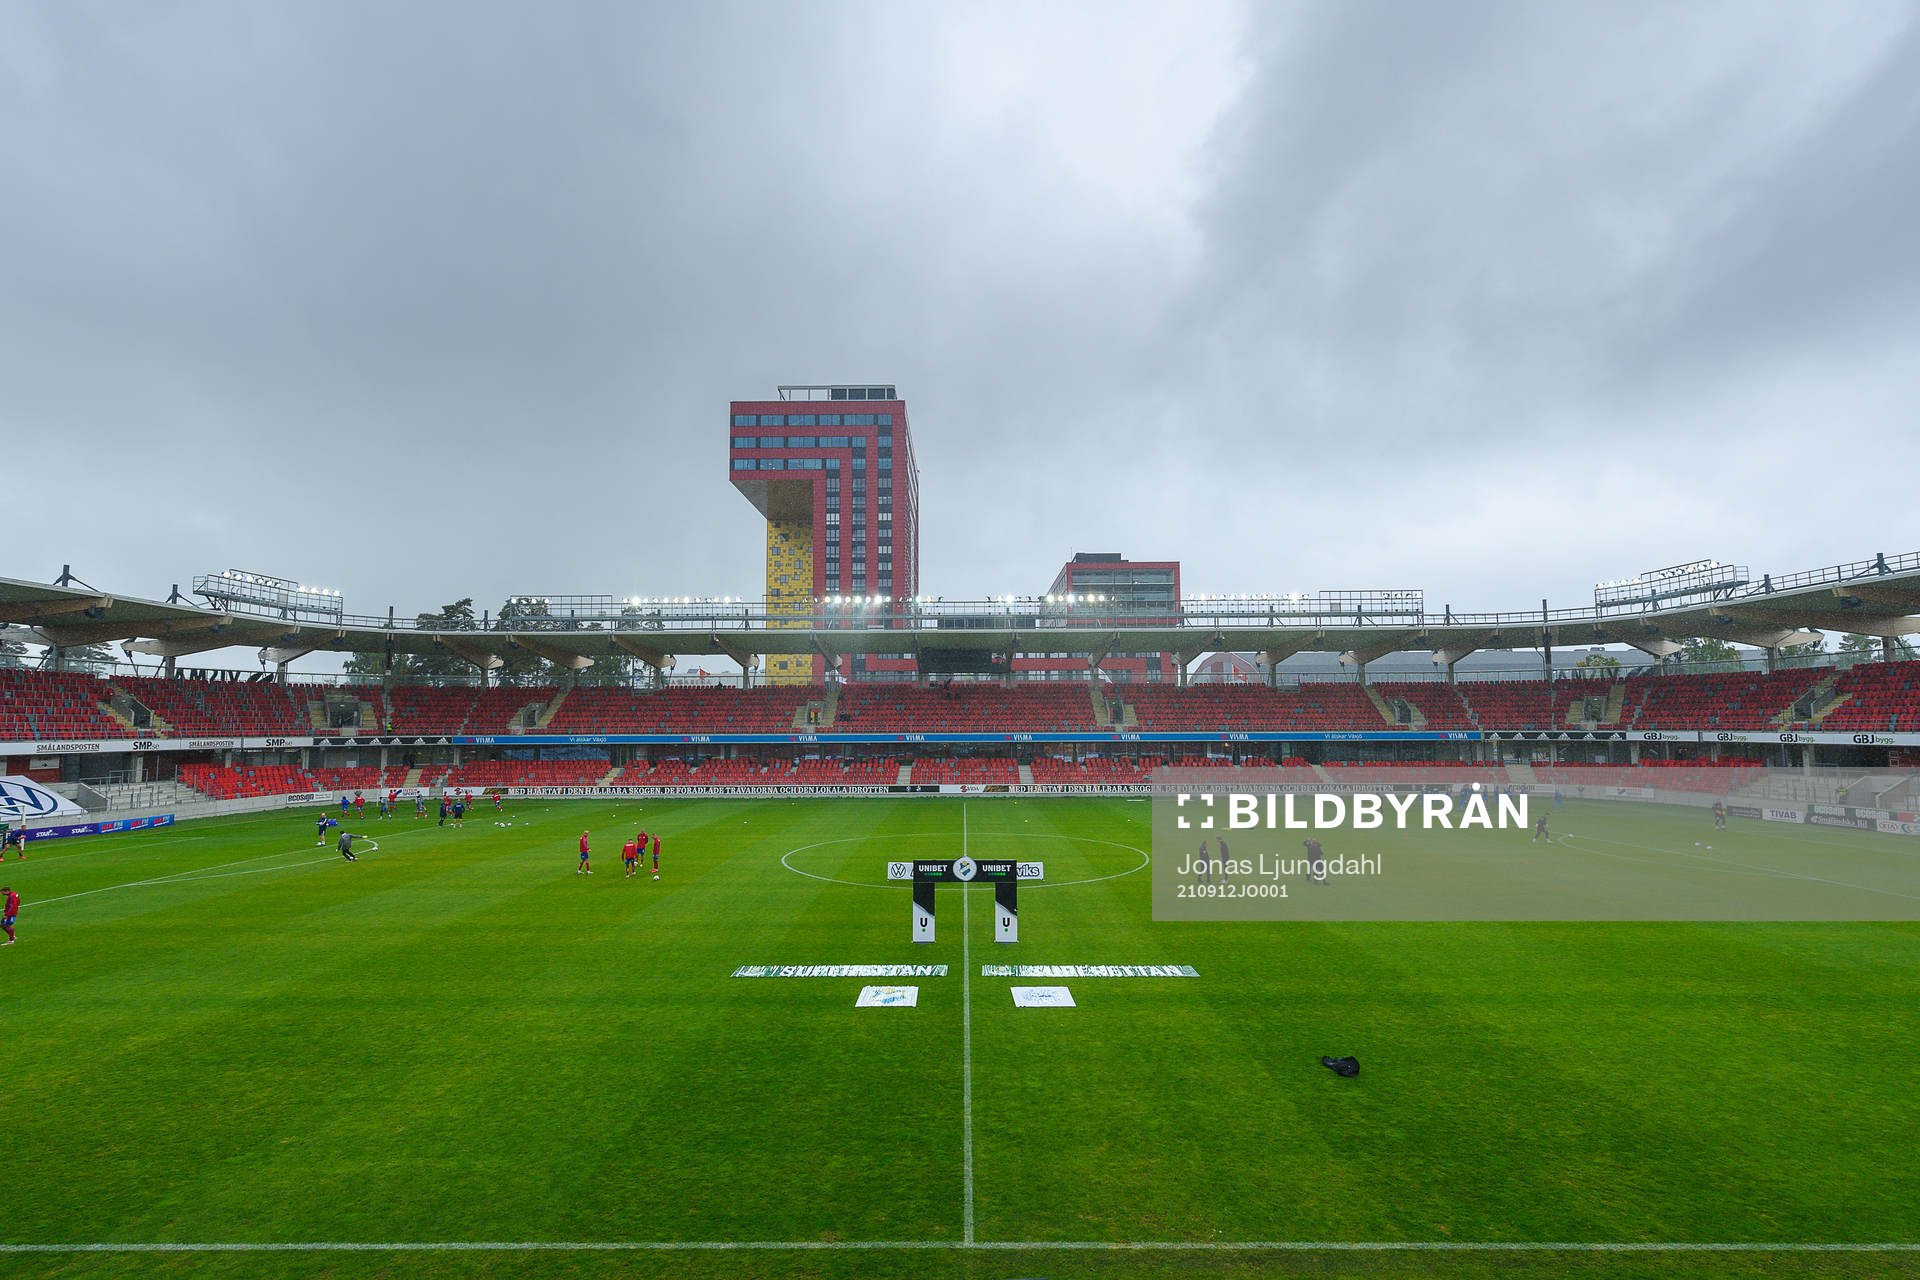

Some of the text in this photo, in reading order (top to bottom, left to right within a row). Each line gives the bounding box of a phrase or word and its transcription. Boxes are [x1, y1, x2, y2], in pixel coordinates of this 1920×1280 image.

[1643, 732, 1662, 740] GBJ
[1717, 733, 1733, 741] GBJ
[1779, 733, 1798, 742] GBJ
[1853, 734, 1875, 744] GBJ
[36, 743, 100, 752] SMÅLANDSPOSTEN
[1769, 809, 1797, 819] TIVAB
[918, 864, 948, 872] UNIBET
[982, 864, 1012, 872] UNIBET
[920, 917, 928, 928] U
[1002, 917, 1010, 928] U
